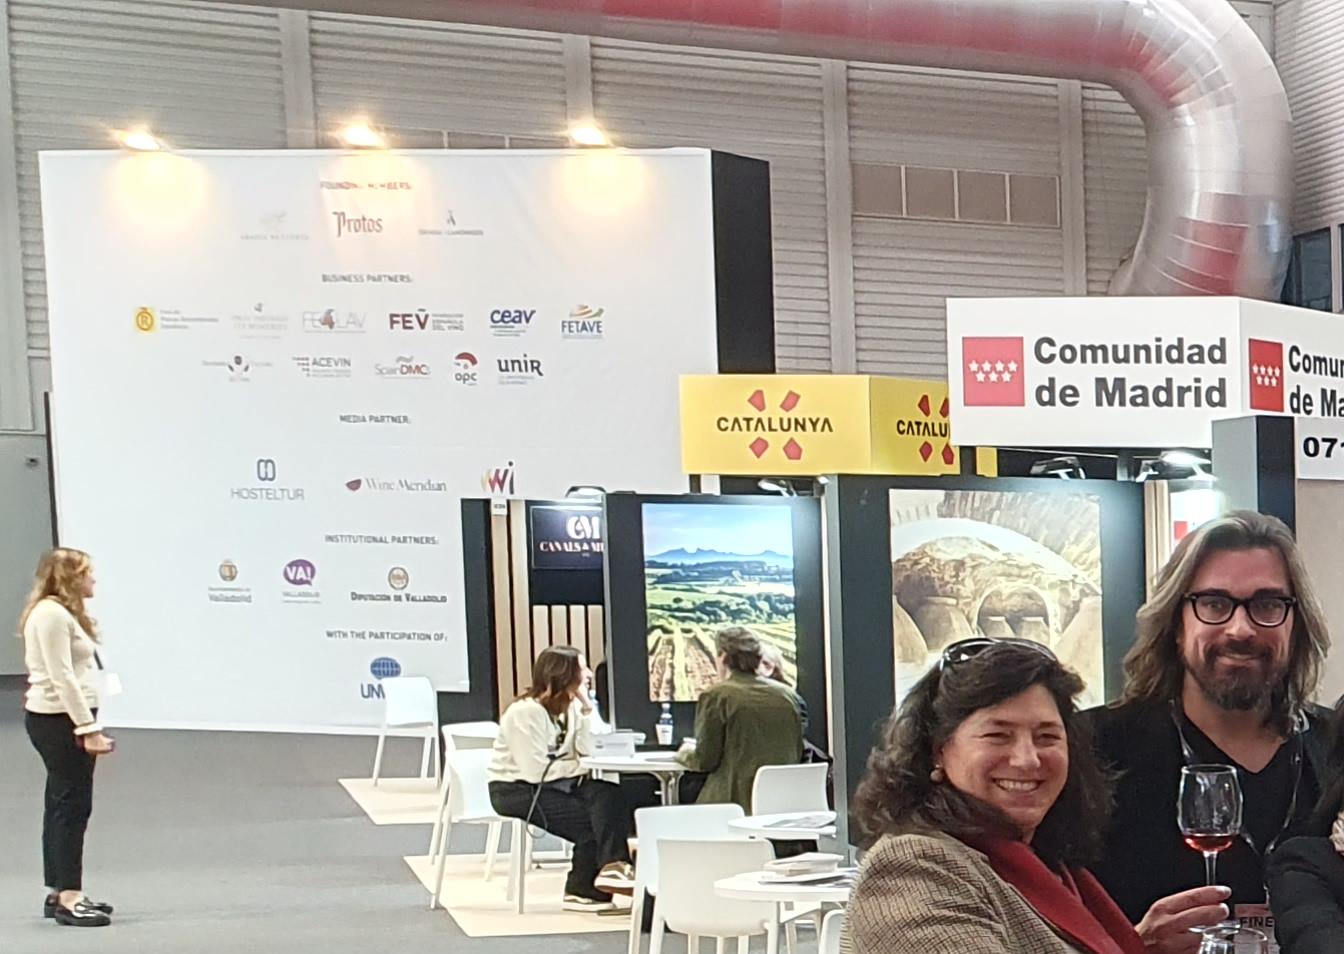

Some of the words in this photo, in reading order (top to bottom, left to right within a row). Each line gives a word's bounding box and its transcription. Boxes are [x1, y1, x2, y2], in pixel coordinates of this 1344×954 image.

[332, 211, 383, 237] Protos
[321, 274, 364, 283] BUSINESS
[490, 309, 536, 325] ceav
[561, 320, 603, 334] FETAVE
[1034, 337, 1227, 364] Comunidad
[312, 357, 351, 367] ACEVIN
[455, 372, 478, 385] opc
[1035, 377, 1080, 407] de
[1095, 377, 1227, 407] Madrid
[1289, 384, 1313, 415] de
[340, 415, 367, 424] MEDIA
[716, 417, 833, 432] CATALUNYA
[896, 420, 949, 437] CATALU
[365, 478, 395, 491] Wine
[398, 479, 447, 492] Meridian
[231, 488, 305, 500] HOSTELTUR
[325, 535, 388, 544] INSTITUTIONAL
[326, 630, 348, 639] WITH
[350, 631, 366, 640] THE
[369, 631, 431, 641] PARTICIPATION
[1240, 916, 1273, 928] FINE
